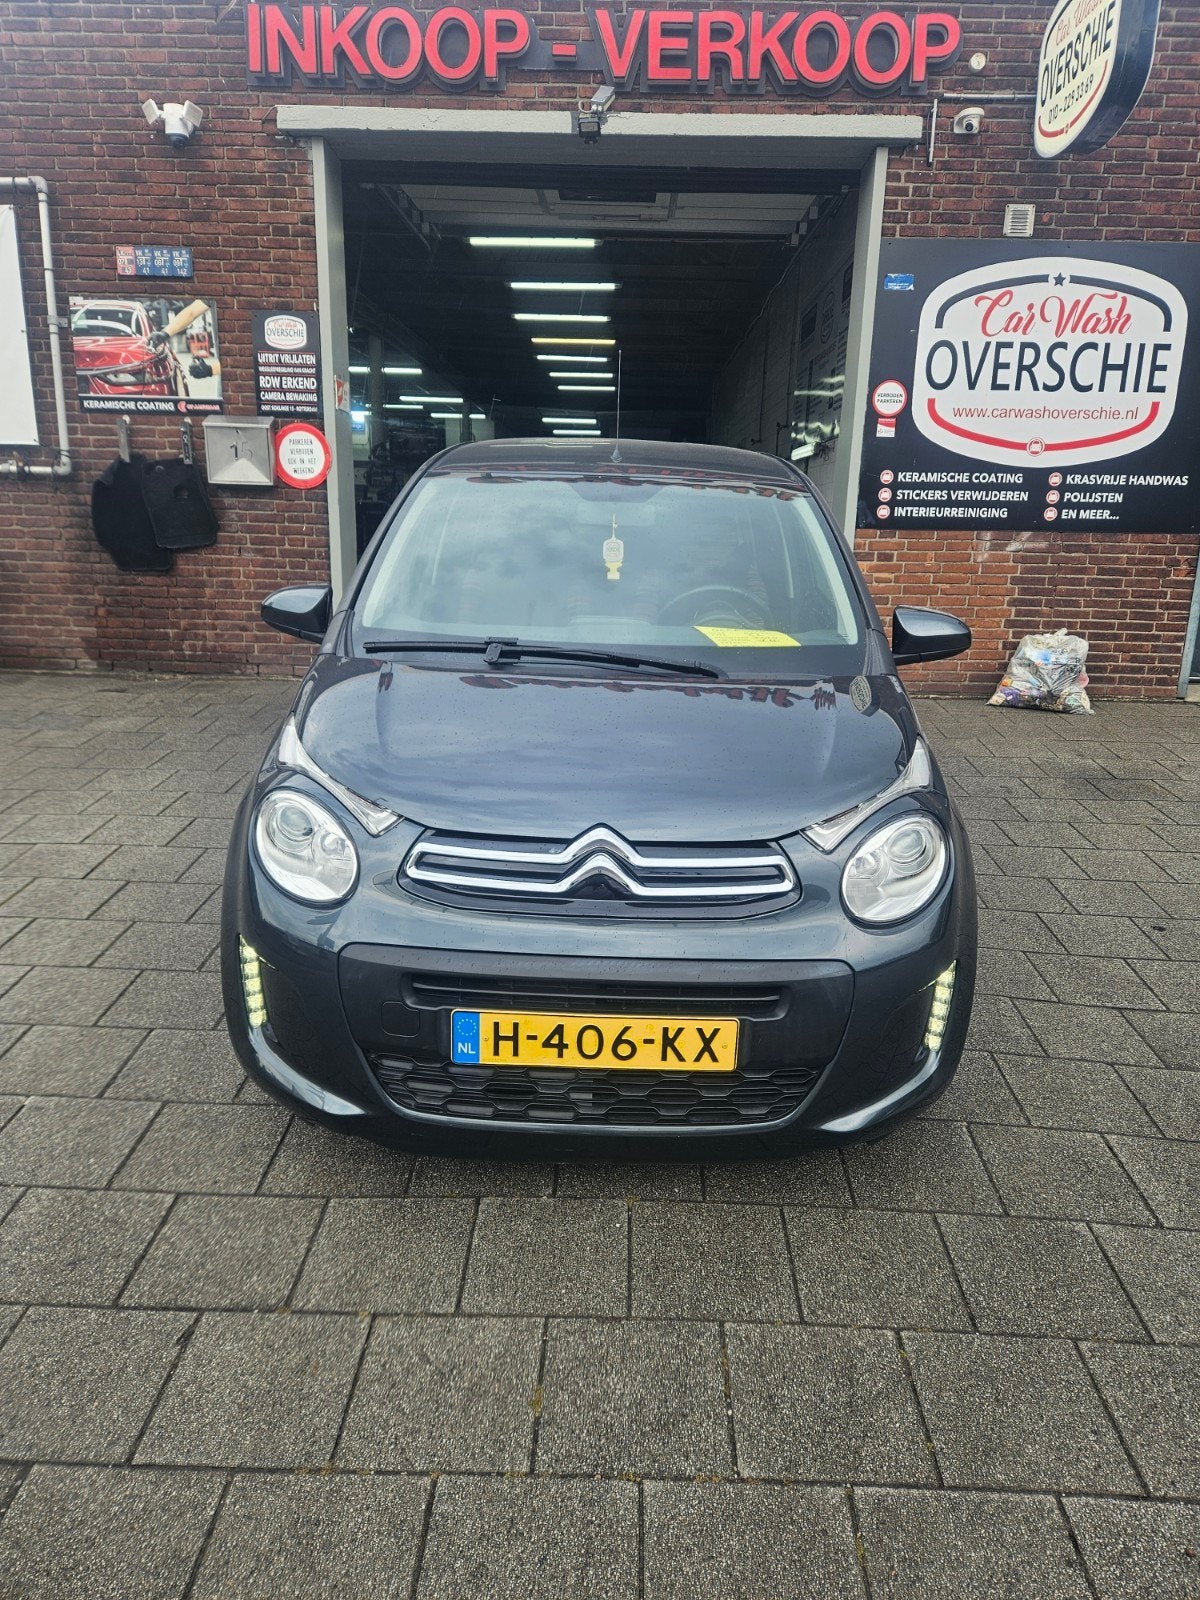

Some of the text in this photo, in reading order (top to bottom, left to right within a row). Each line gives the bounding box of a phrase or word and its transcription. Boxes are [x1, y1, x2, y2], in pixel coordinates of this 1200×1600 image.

[1056, 18, 1070, 46] Car
[248, 4, 961, 84] INKOOP - VERKOOP
[1041, 0, 1116, 107] OVERSCHIE
[973, 289, 1133, 338] Car Wash
[265, 328, 305, 338] OVERSCHIE
[258, 353, 316, 365] UITRIT VRIJLATEN
[925, 340, 1172, 393] OVERSCHIE
[259, 376, 317, 389] RDW ERKEND
[260, 391, 318, 402] CAMERA BEWAKING
[83, 400, 136, 409] KERAMISCHE
[137, 402, 175, 411] COATING
[952, 405, 1139, 420] www.carwashoverschie.nl
[230, 441, 253, 461] 15
[897, 472, 1023, 484] KERAMISCHE COATING
[1066, 474, 1189, 486] KRASVRIJE HANDWAS
[896, 490, 1029, 501] STICKERS VERWIJDEREN
[1063, 492, 1123, 503] POLIJSTEN
[894, 507, 1008, 518] INTERIEURREINIGING
[1061, 509, 1120, 520] EN MEER...
[457, 1042, 476, 1054] NL
[493, 1021, 721, 1063] H-406-KX
